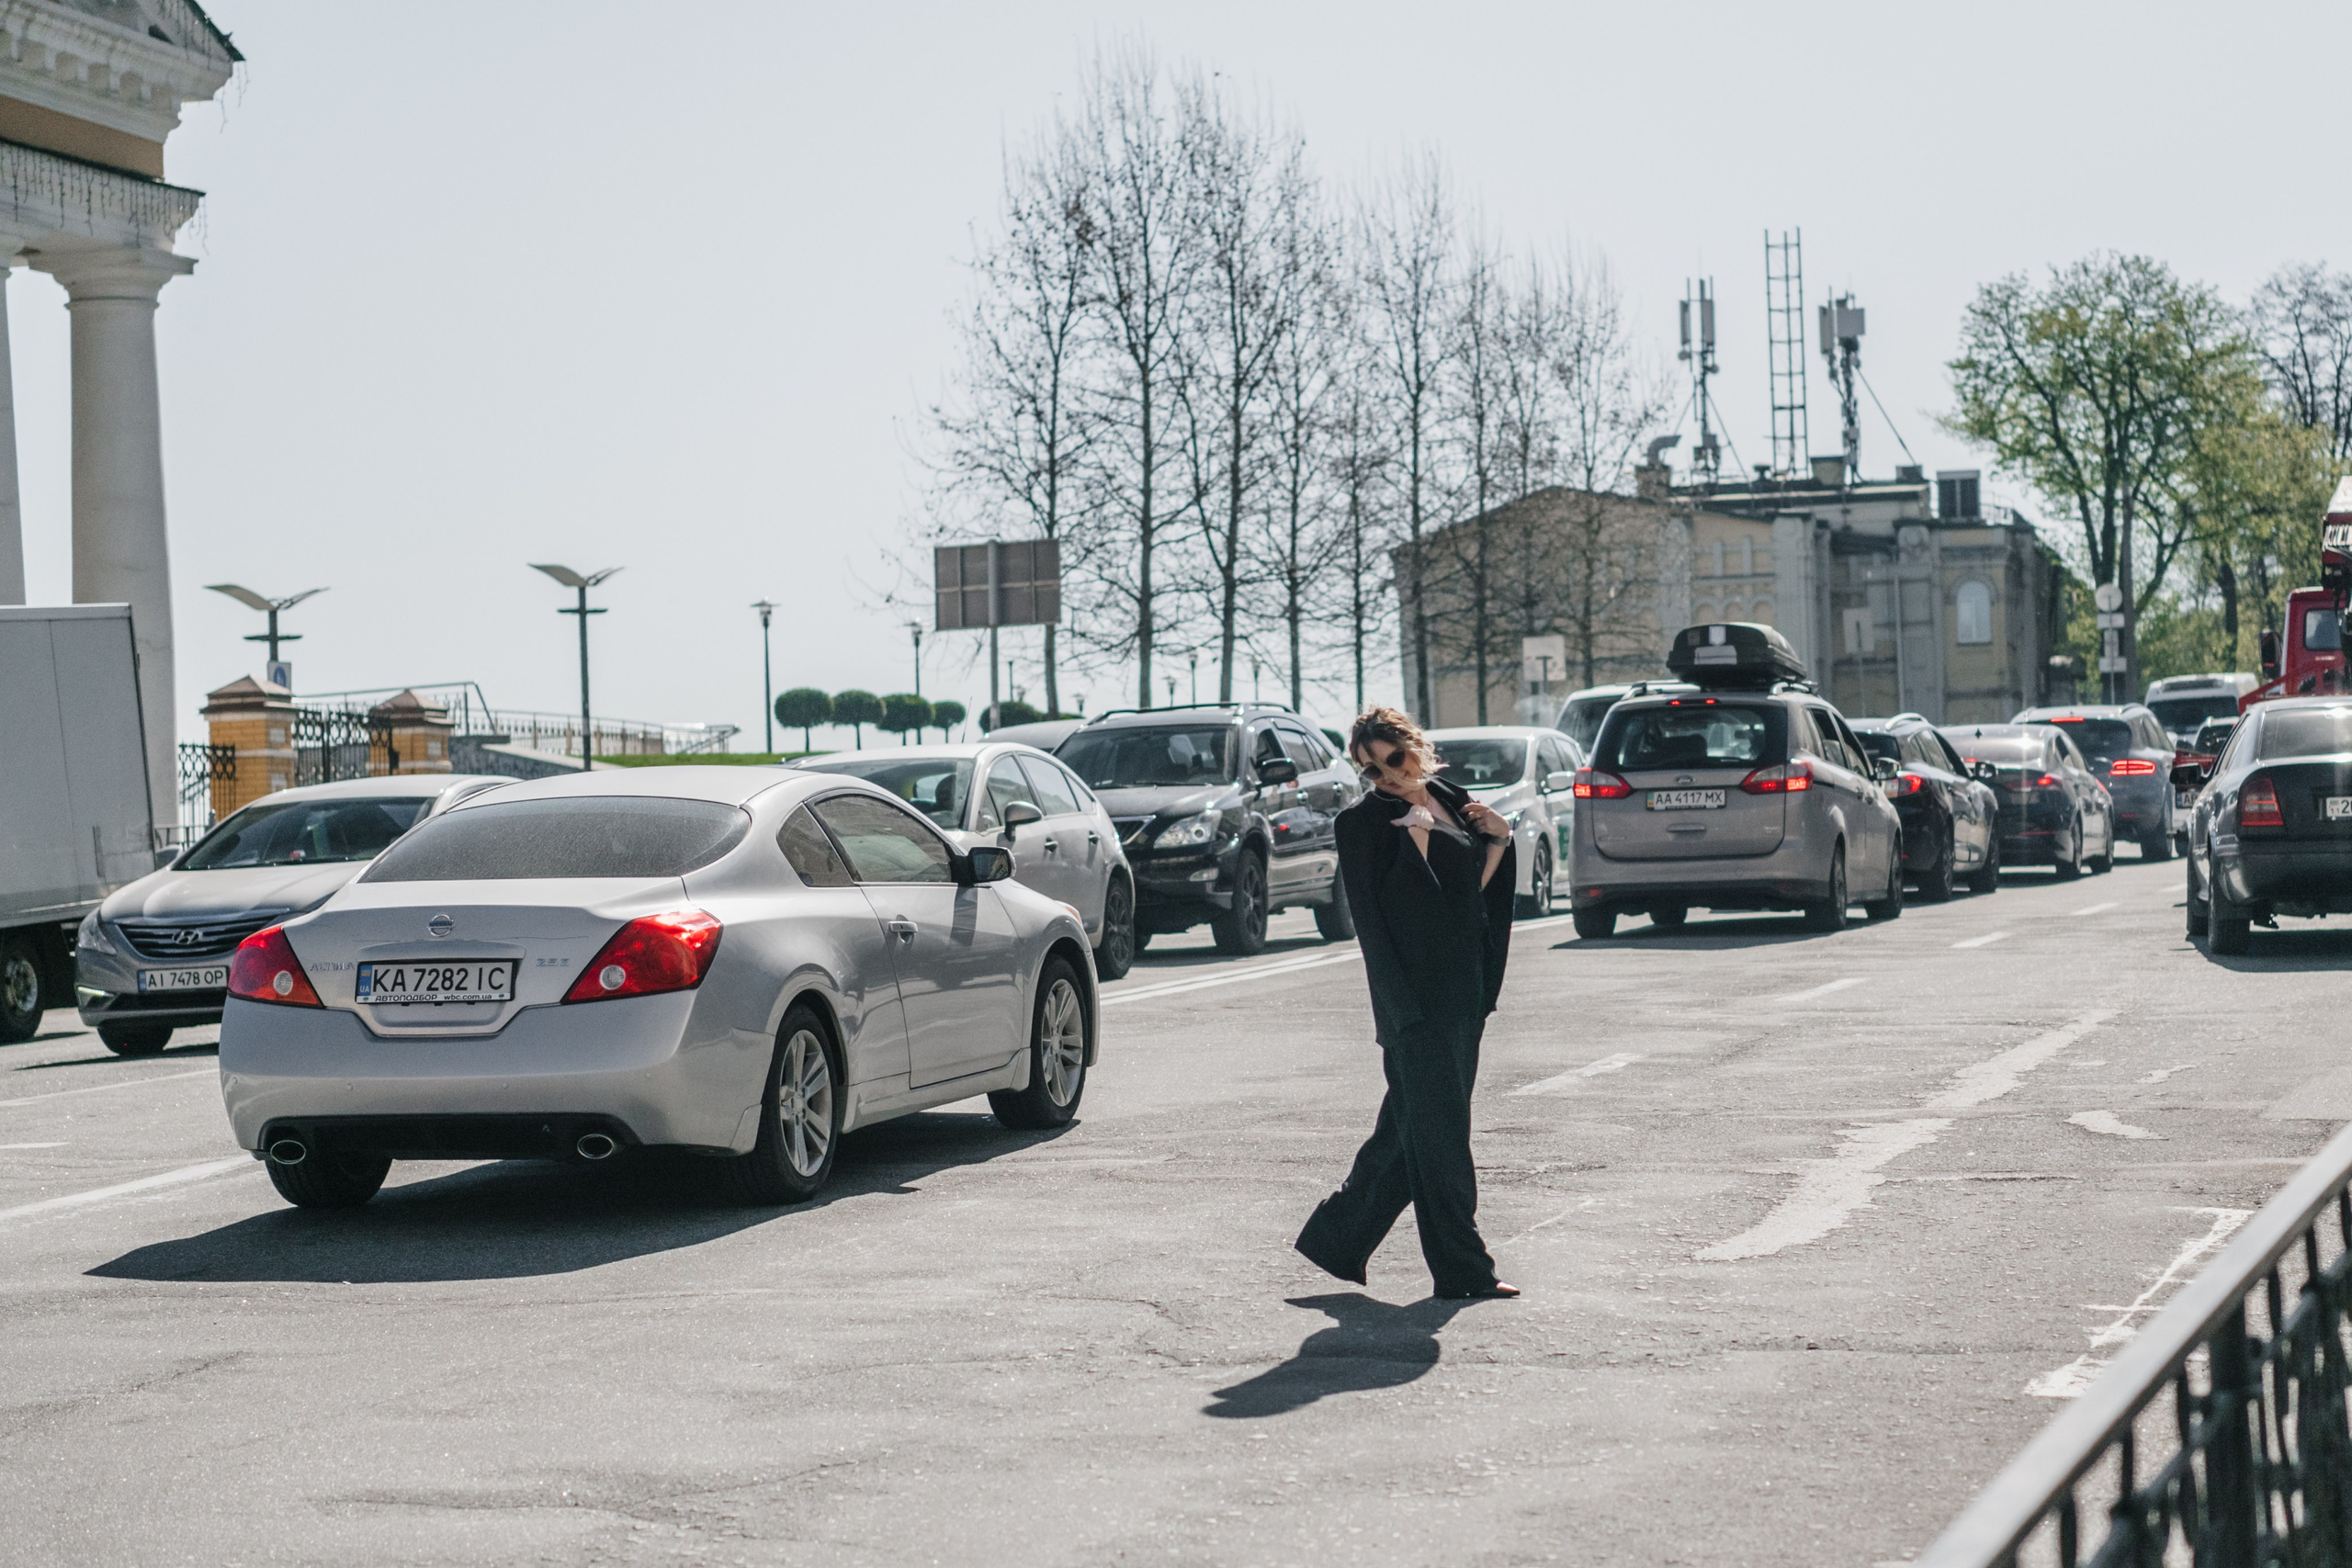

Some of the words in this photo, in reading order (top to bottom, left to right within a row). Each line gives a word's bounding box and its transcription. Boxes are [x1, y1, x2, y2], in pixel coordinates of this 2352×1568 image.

[1656, 793, 1672, 805] AA
[1675, 791, 1702, 804] 4117
[1705, 791, 1723, 803] MX
[148, 973, 164, 987] AI
[170, 971, 200, 987] 7478
[204, 970, 223, 985] OP
[372, 967, 406, 993] KA
[413, 967, 469, 992] 7282
[477, 966, 504, 991] IC
[359, 985, 370, 993] UA
[375, 994, 437, 1002] АВТОПОДБОР
